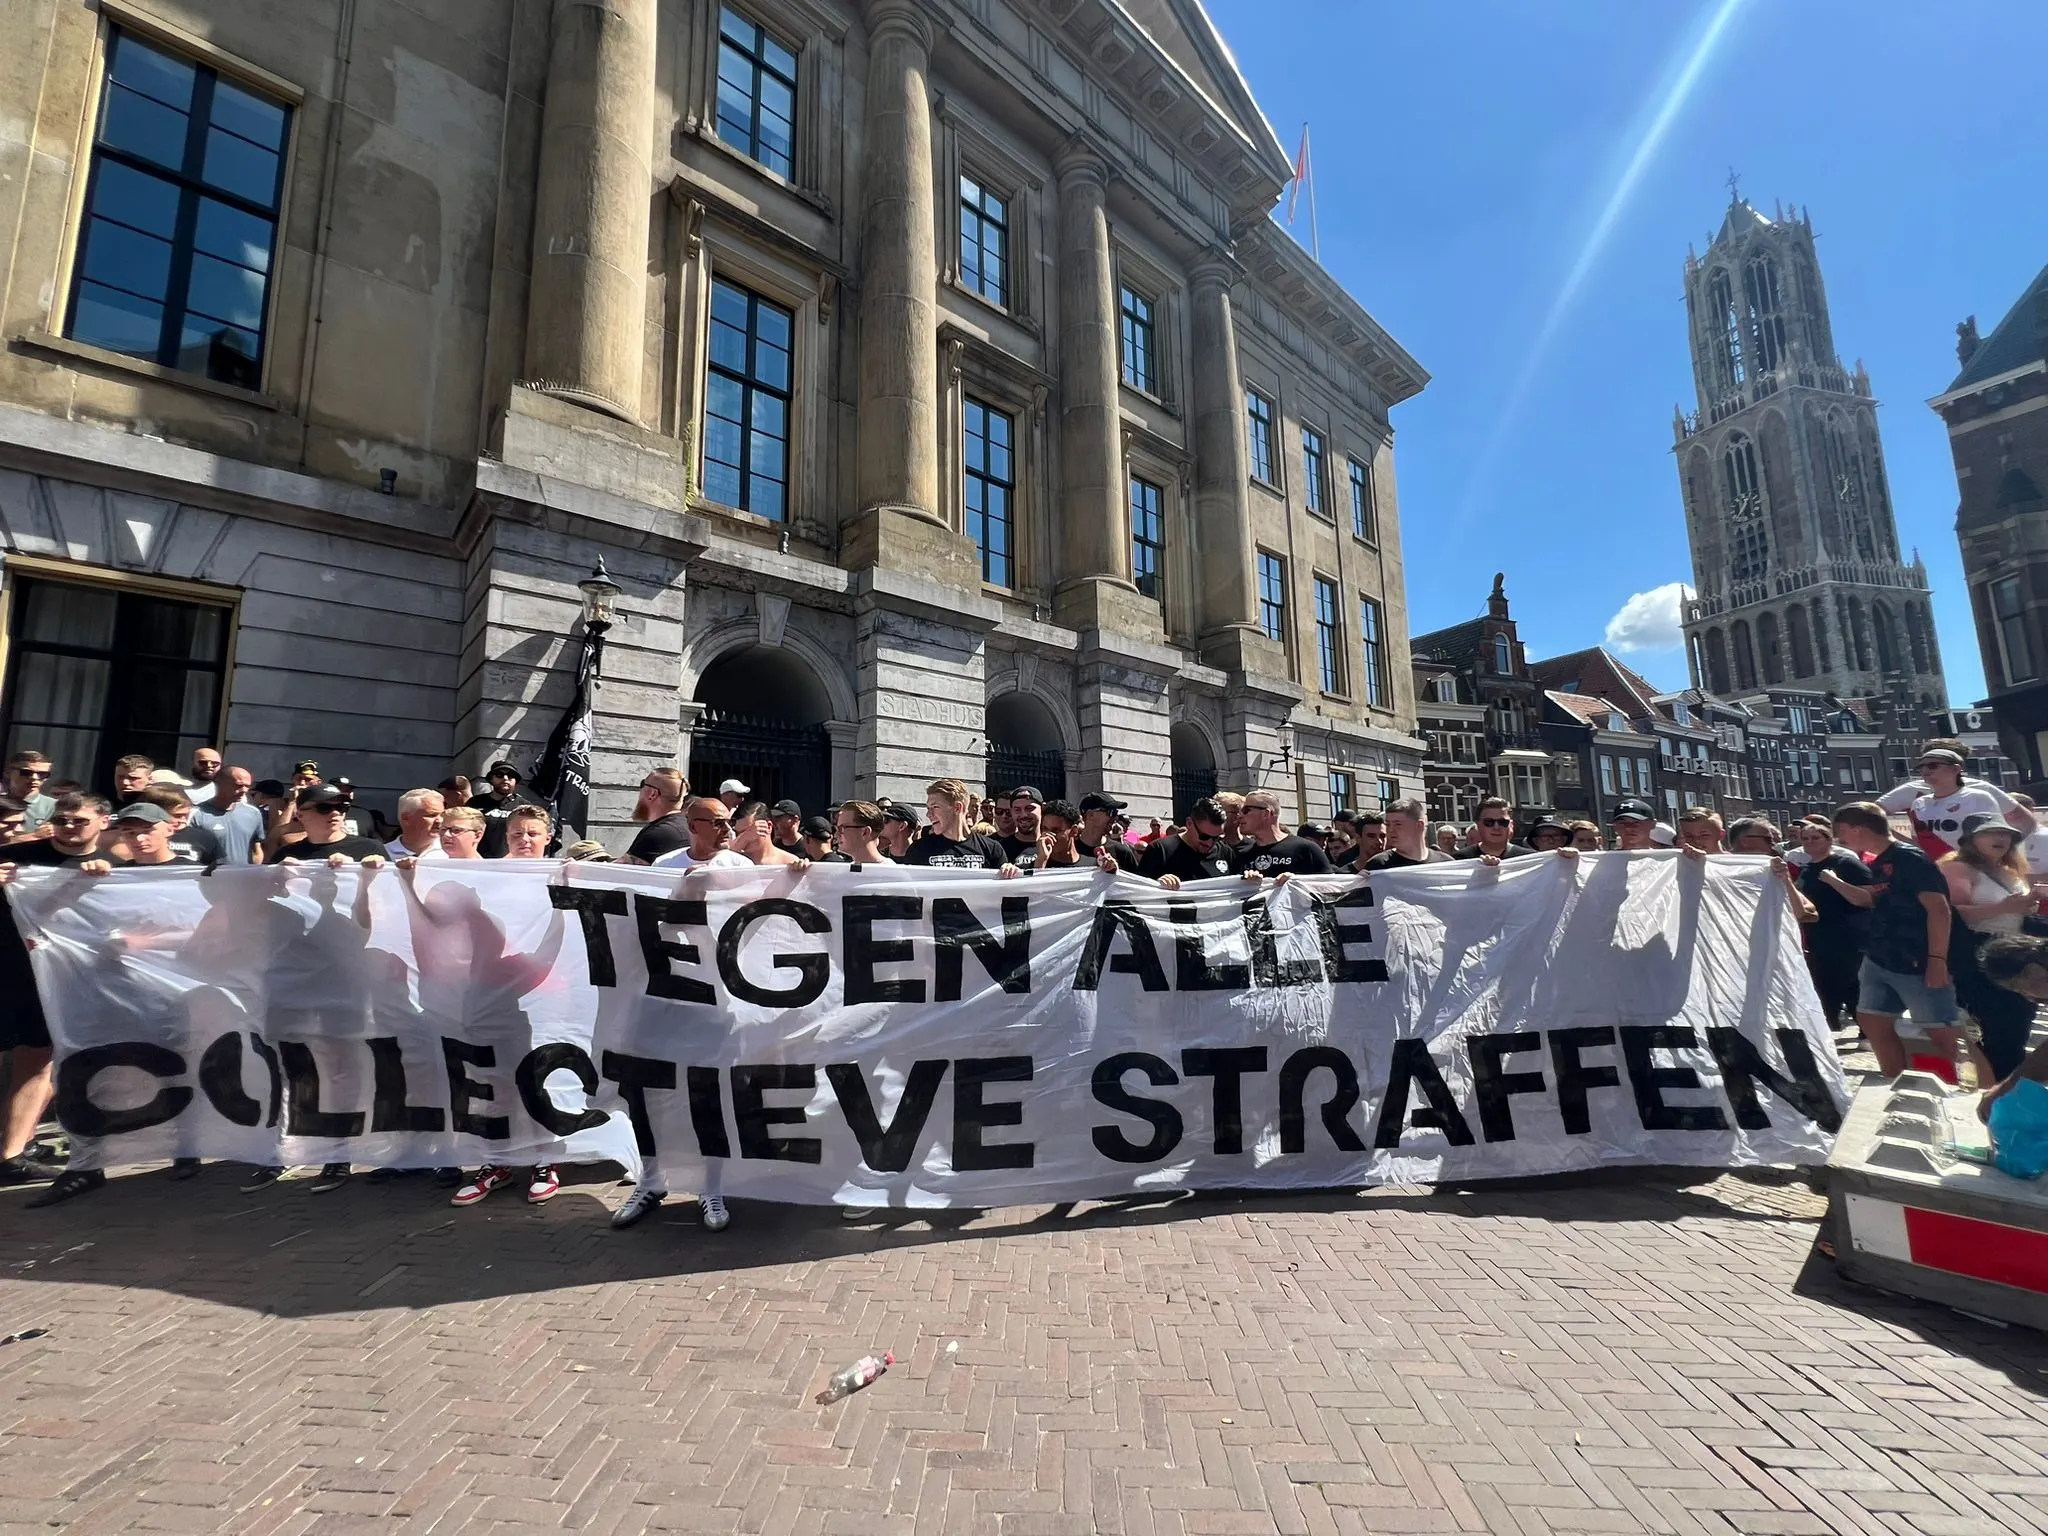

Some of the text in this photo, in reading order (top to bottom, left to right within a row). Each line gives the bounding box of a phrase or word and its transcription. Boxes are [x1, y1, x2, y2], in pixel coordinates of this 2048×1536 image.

[549, 884, 1390, 1008] TEGEN ALLE
[55, 1024, 1842, 1173] COLLECTIEVE STRAFFEN
